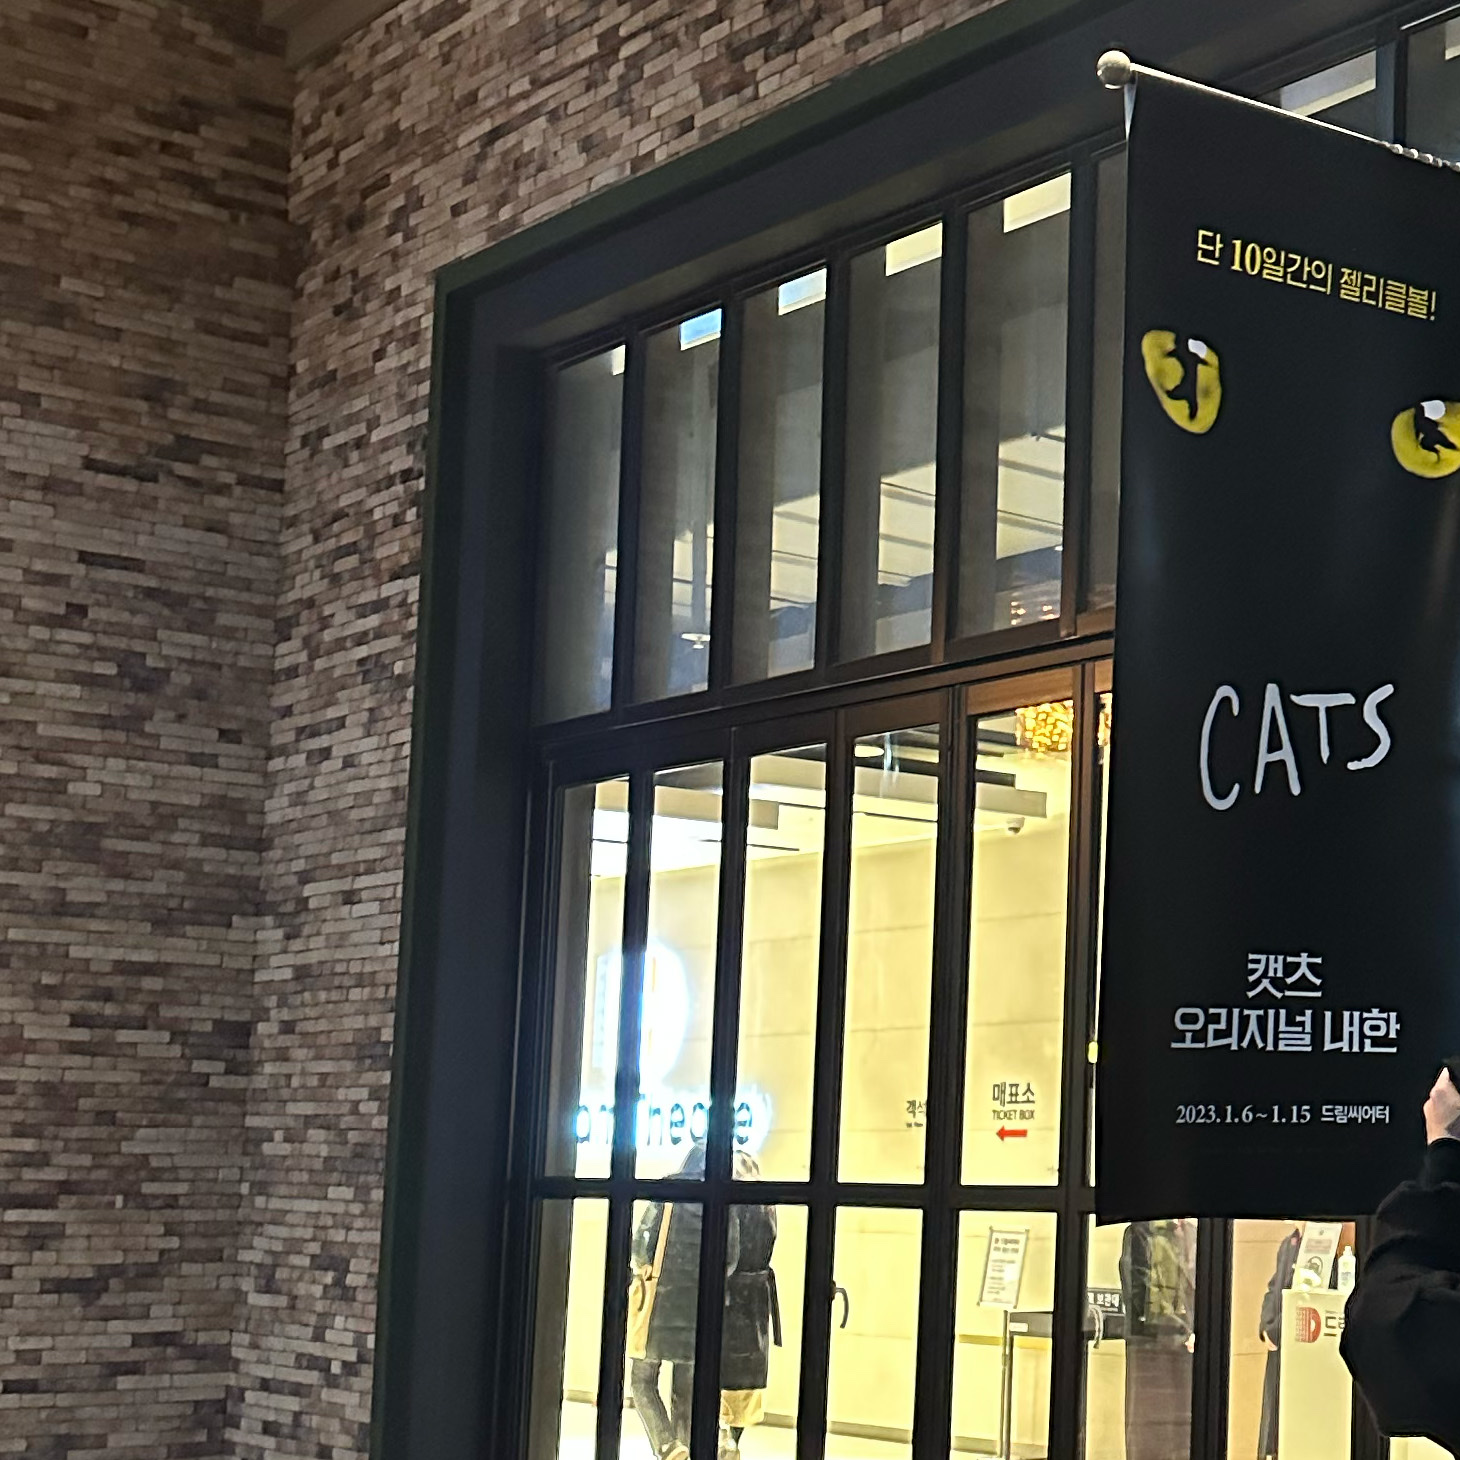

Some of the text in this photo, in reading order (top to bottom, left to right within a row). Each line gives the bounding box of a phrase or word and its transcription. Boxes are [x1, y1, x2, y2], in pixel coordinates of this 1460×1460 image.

[1196, 229, 1437, 321] 단 10일간의 젤리클볼!
[1200, 682, 1395, 811] CATS
[1246, 952, 1323, 999] 캣츠
[1170, 1007, 1401, 1053] 오리지널 내한
[991, 1082, 1036, 1107] 매표소
[1175, 1104, 1390, 1124] 2023.1.6~1.15 드림씨어터
